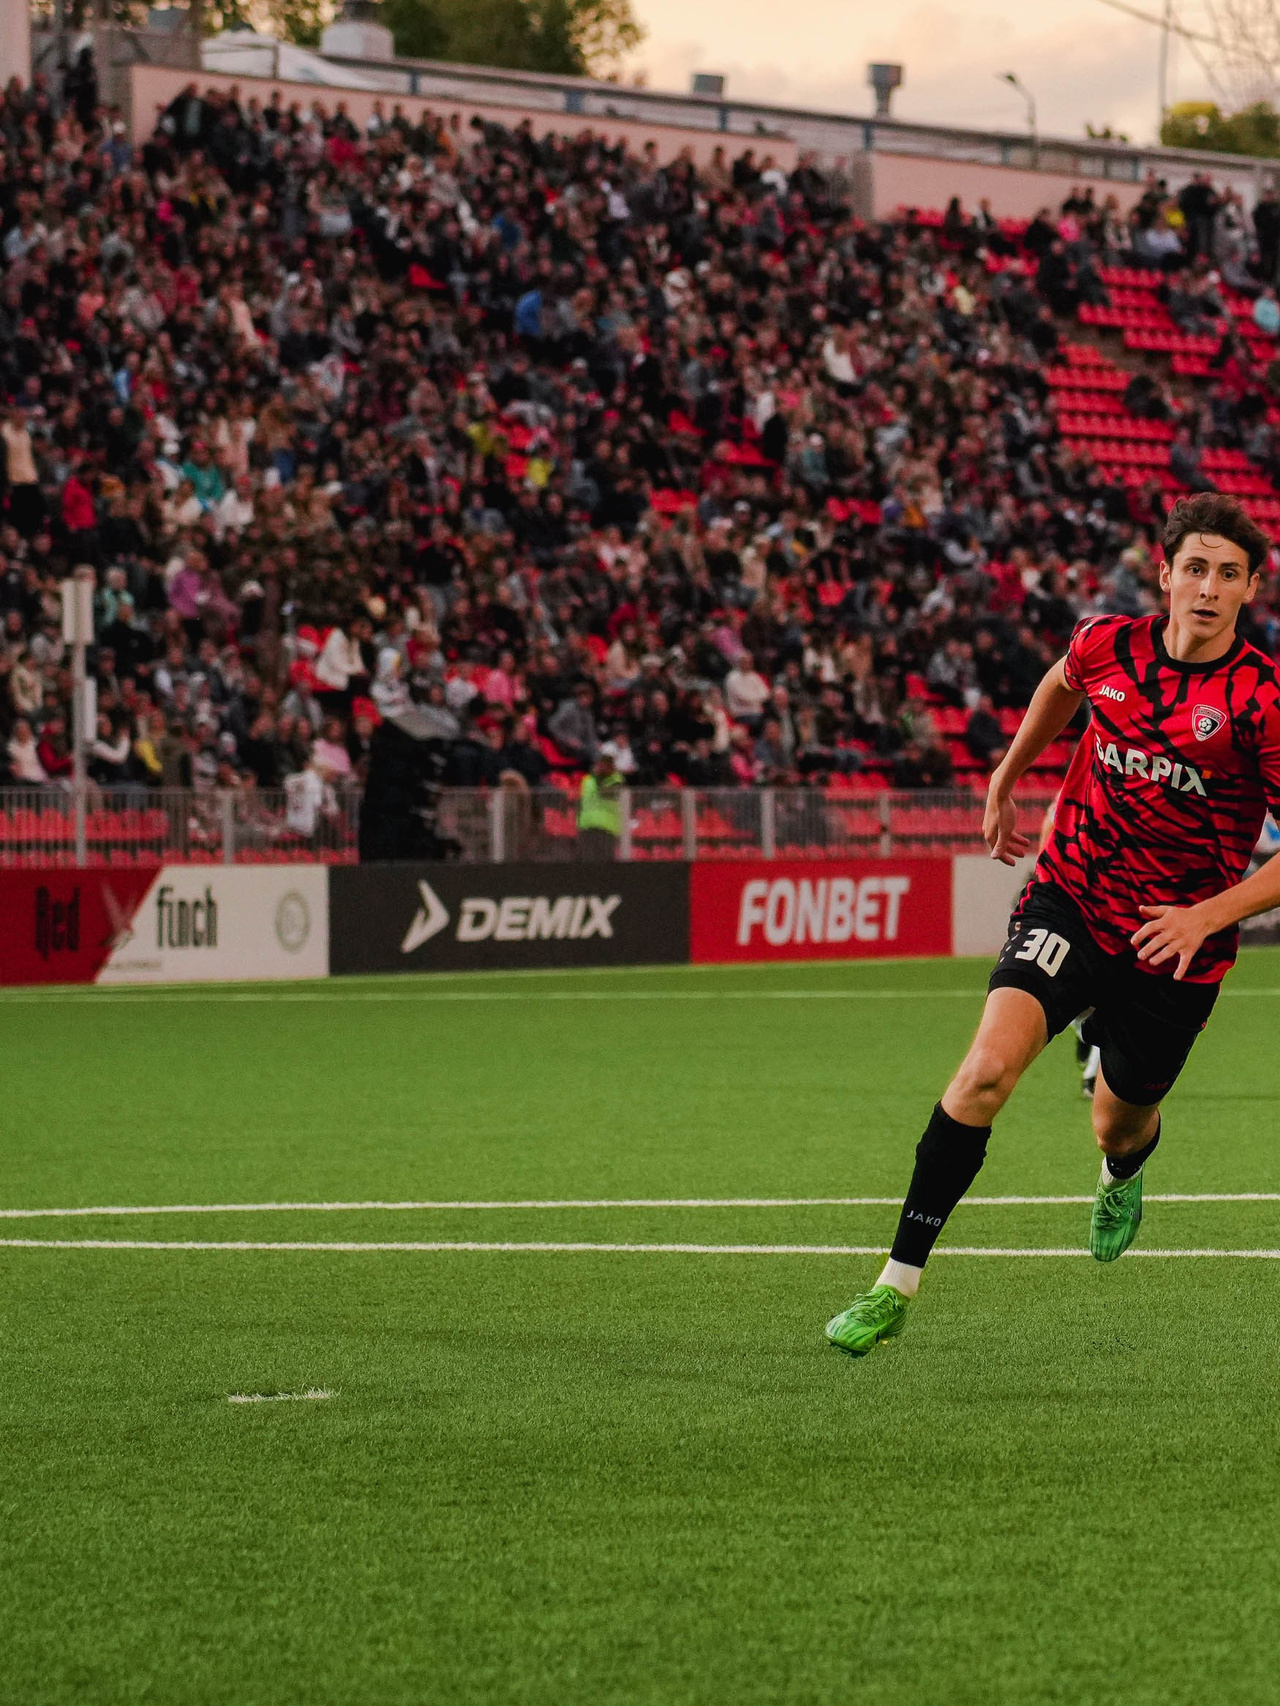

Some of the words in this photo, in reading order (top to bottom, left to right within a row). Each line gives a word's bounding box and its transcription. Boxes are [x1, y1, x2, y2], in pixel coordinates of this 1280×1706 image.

[1099, 684, 1126, 702] JAKO
[155, 884, 218, 948] finch
[456, 894, 621, 942] DEMIX
[736, 876, 910, 945] FONBET
[1014, 928, 1071, 977] 30
[906, 1210, 942, 1227] JAKO
